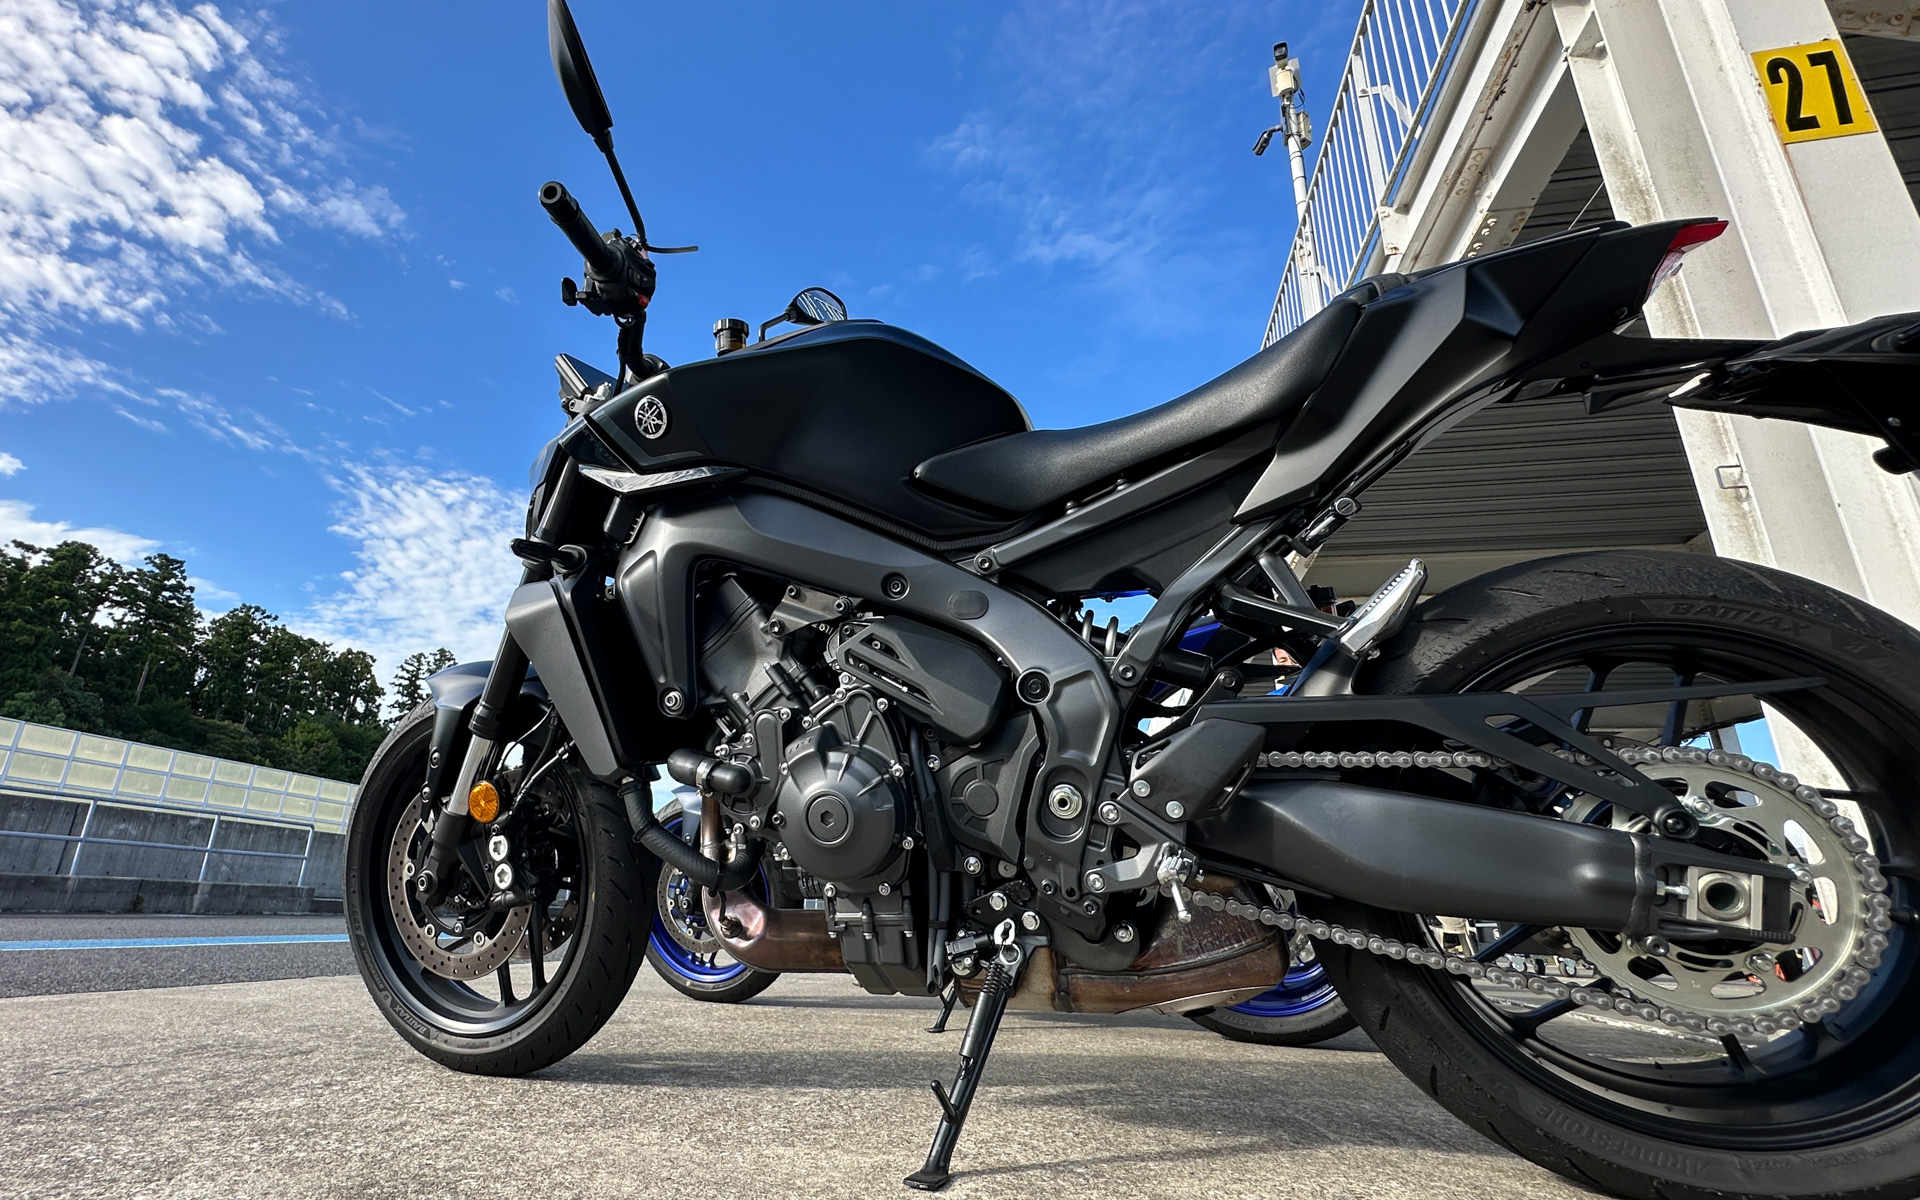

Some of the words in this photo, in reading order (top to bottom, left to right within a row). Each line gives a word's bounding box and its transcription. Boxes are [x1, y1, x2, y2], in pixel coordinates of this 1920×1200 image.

[1766, 50, 1854, 132] 27
[1667, 601, 1810, 638] BATTLAX
[393, 1003, 428, 1036] BATTLAX
[1214, 1010, 1257, 1027] BATTLA
[1533, 1101, 1712, 1180] BRIDGESTONE
